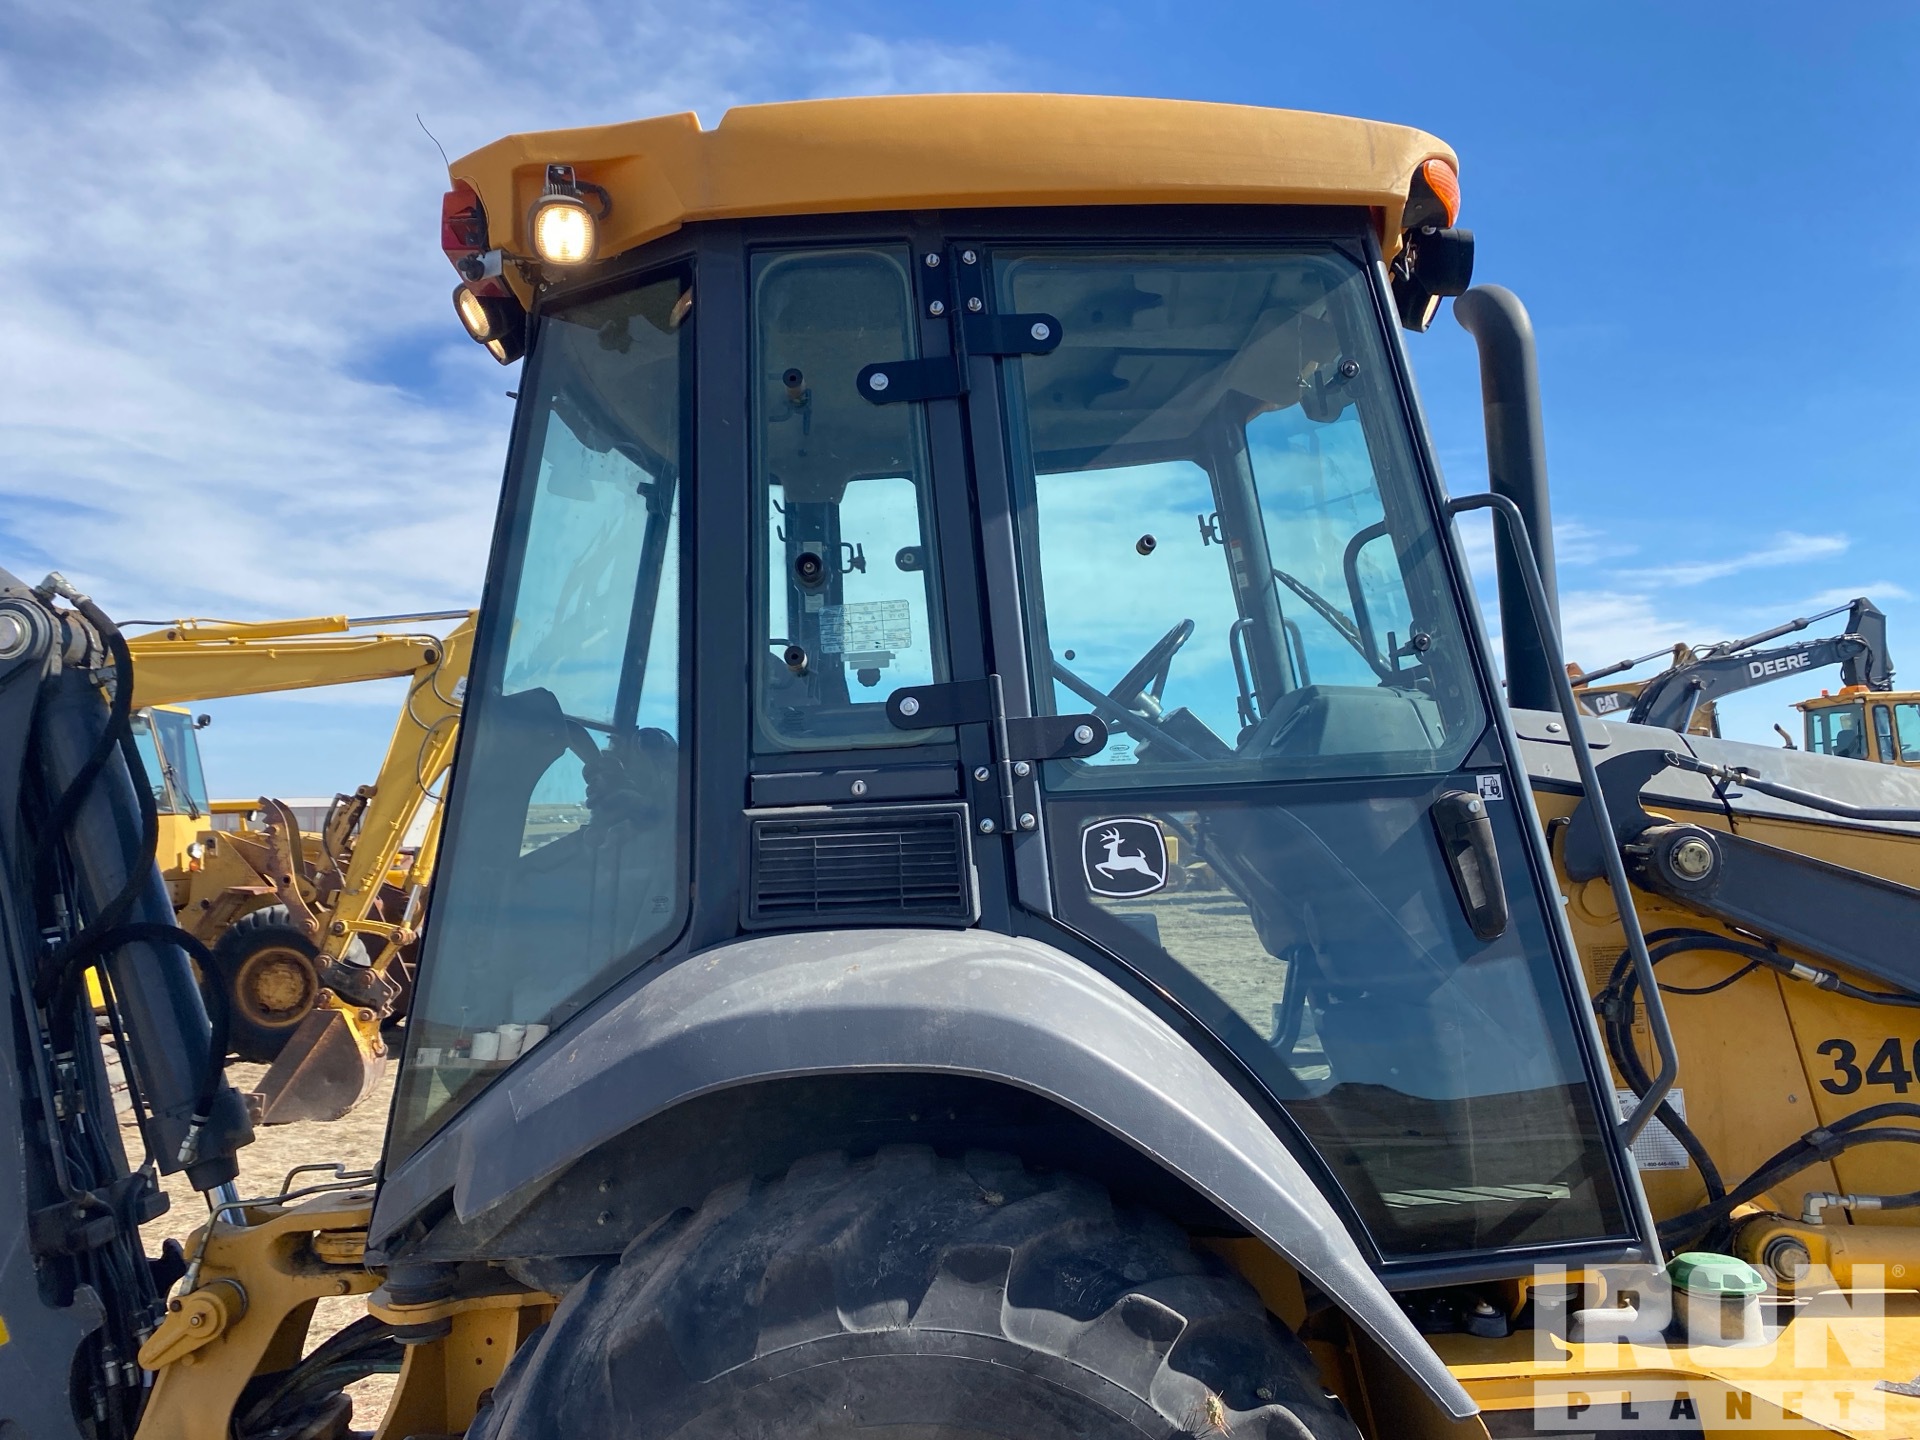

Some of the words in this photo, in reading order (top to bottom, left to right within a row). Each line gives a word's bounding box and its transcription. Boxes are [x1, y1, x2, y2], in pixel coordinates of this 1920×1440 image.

[1749, 652, 1811, 679] DEERE
[1595, 692, 1620, 713] CAT
[1816, 1037, 1920, 1095] 34
